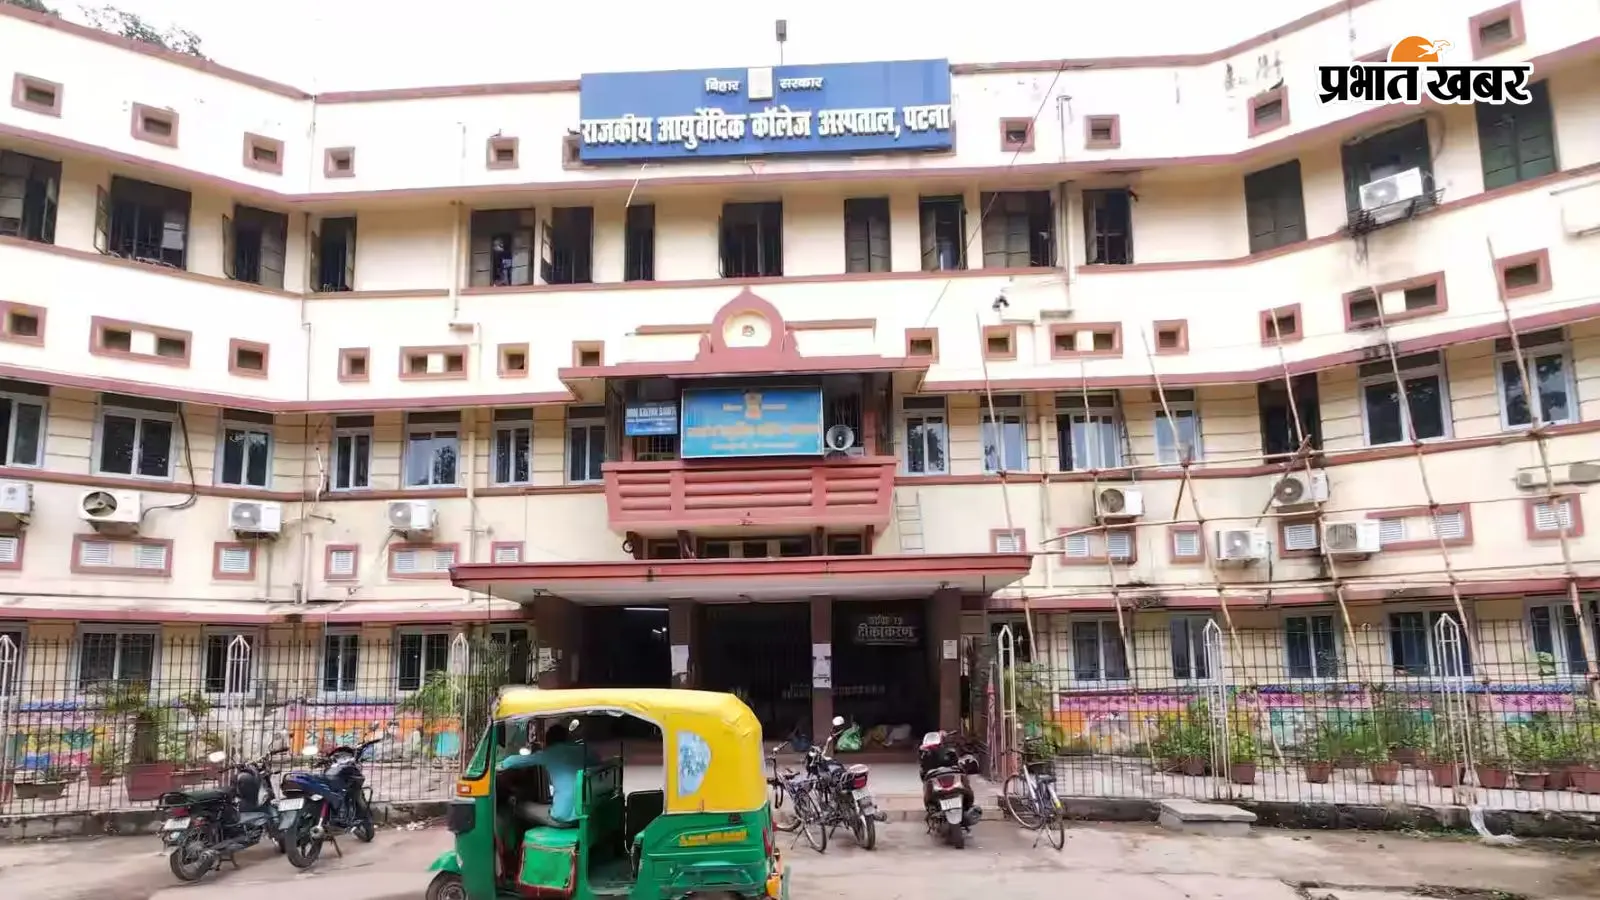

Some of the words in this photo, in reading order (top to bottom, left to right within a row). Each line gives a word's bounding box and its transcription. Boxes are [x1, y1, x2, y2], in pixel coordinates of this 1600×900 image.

[705, 77, 740, 92] बिहार
[779, 77, 824, 90] सरकार
[581, 113, 653, 144] राजकीय
[657, 107, 747, 150] आयुर्वेदिक
[750, 104, 812, 138] कॉलेज
[818, 107, 901, 139] अस्पताल,
[903, 104, 950, 132] पटना
